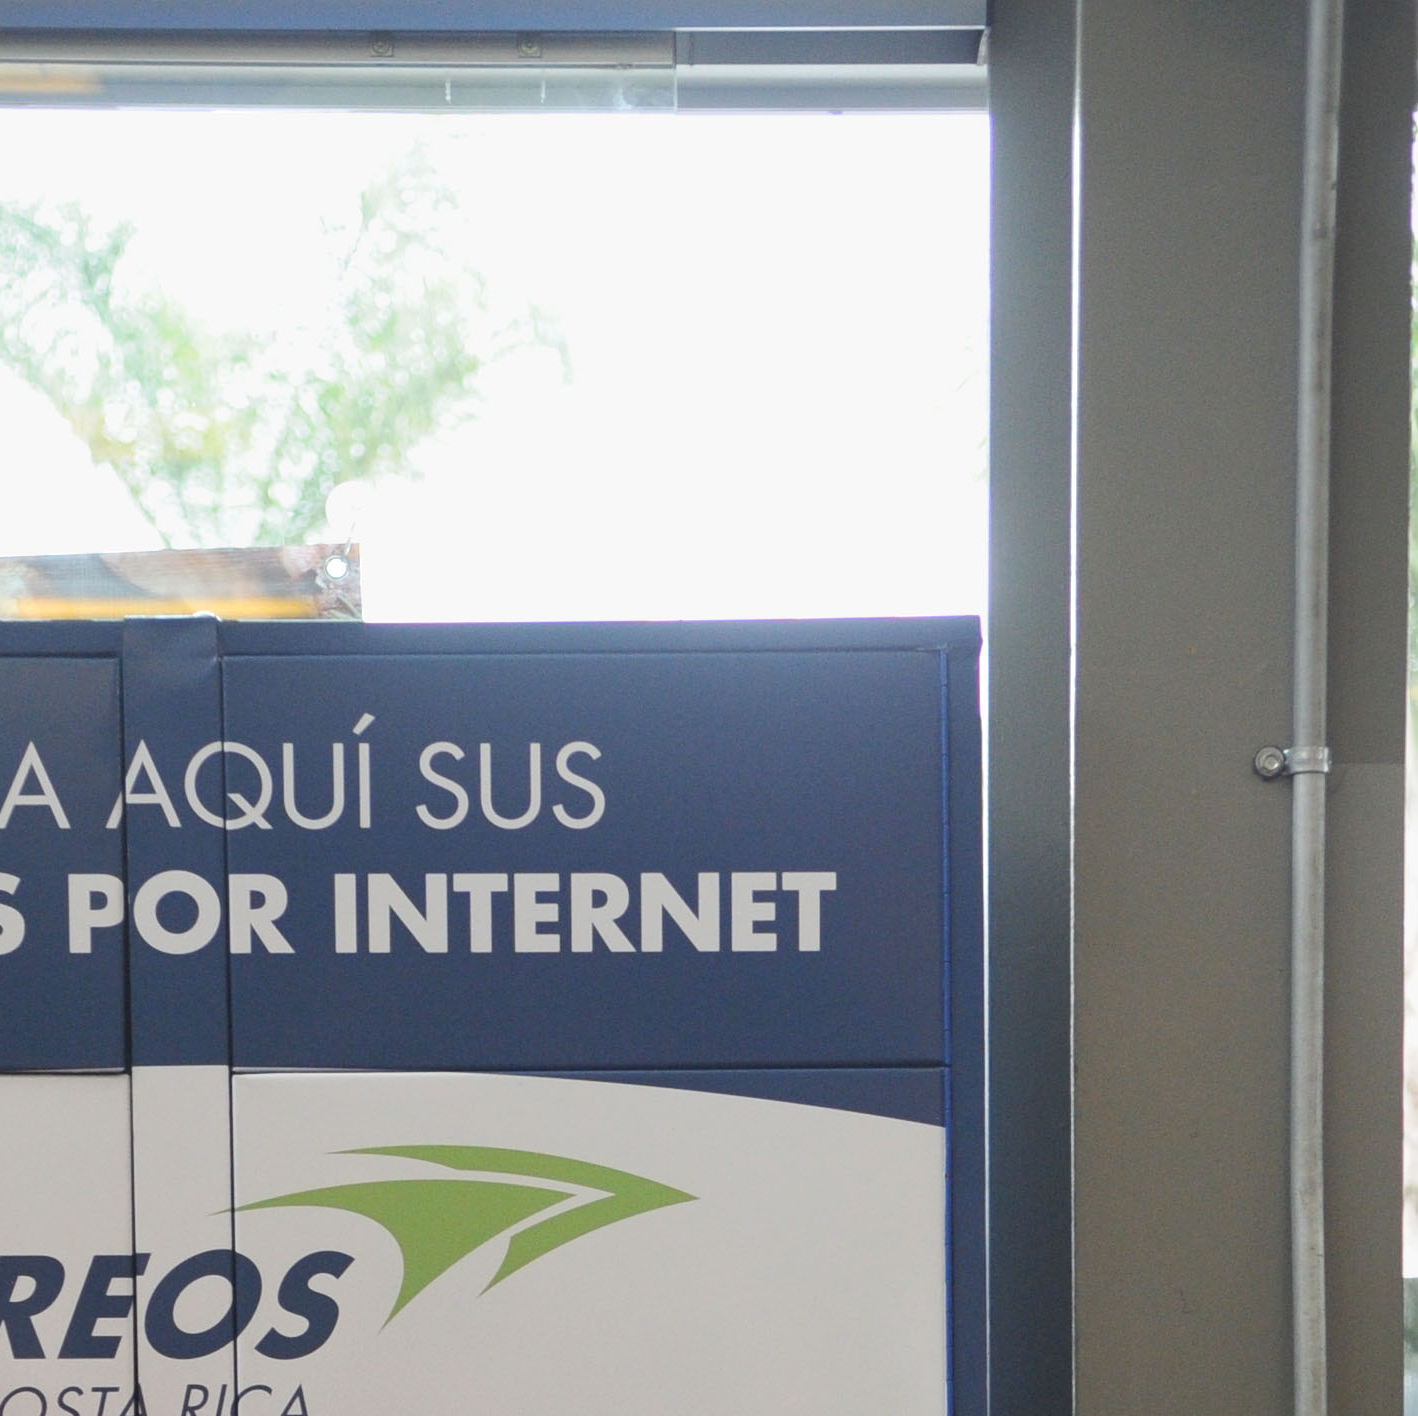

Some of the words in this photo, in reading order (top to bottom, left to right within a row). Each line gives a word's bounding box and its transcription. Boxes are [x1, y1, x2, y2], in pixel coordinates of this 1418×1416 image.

[105, 713, 375, 830] AQUÍ
[416, 740, 605, 830] SUS
[67, 870, 294, 954] POR
[334, 872, 836, 953] INTERNET
